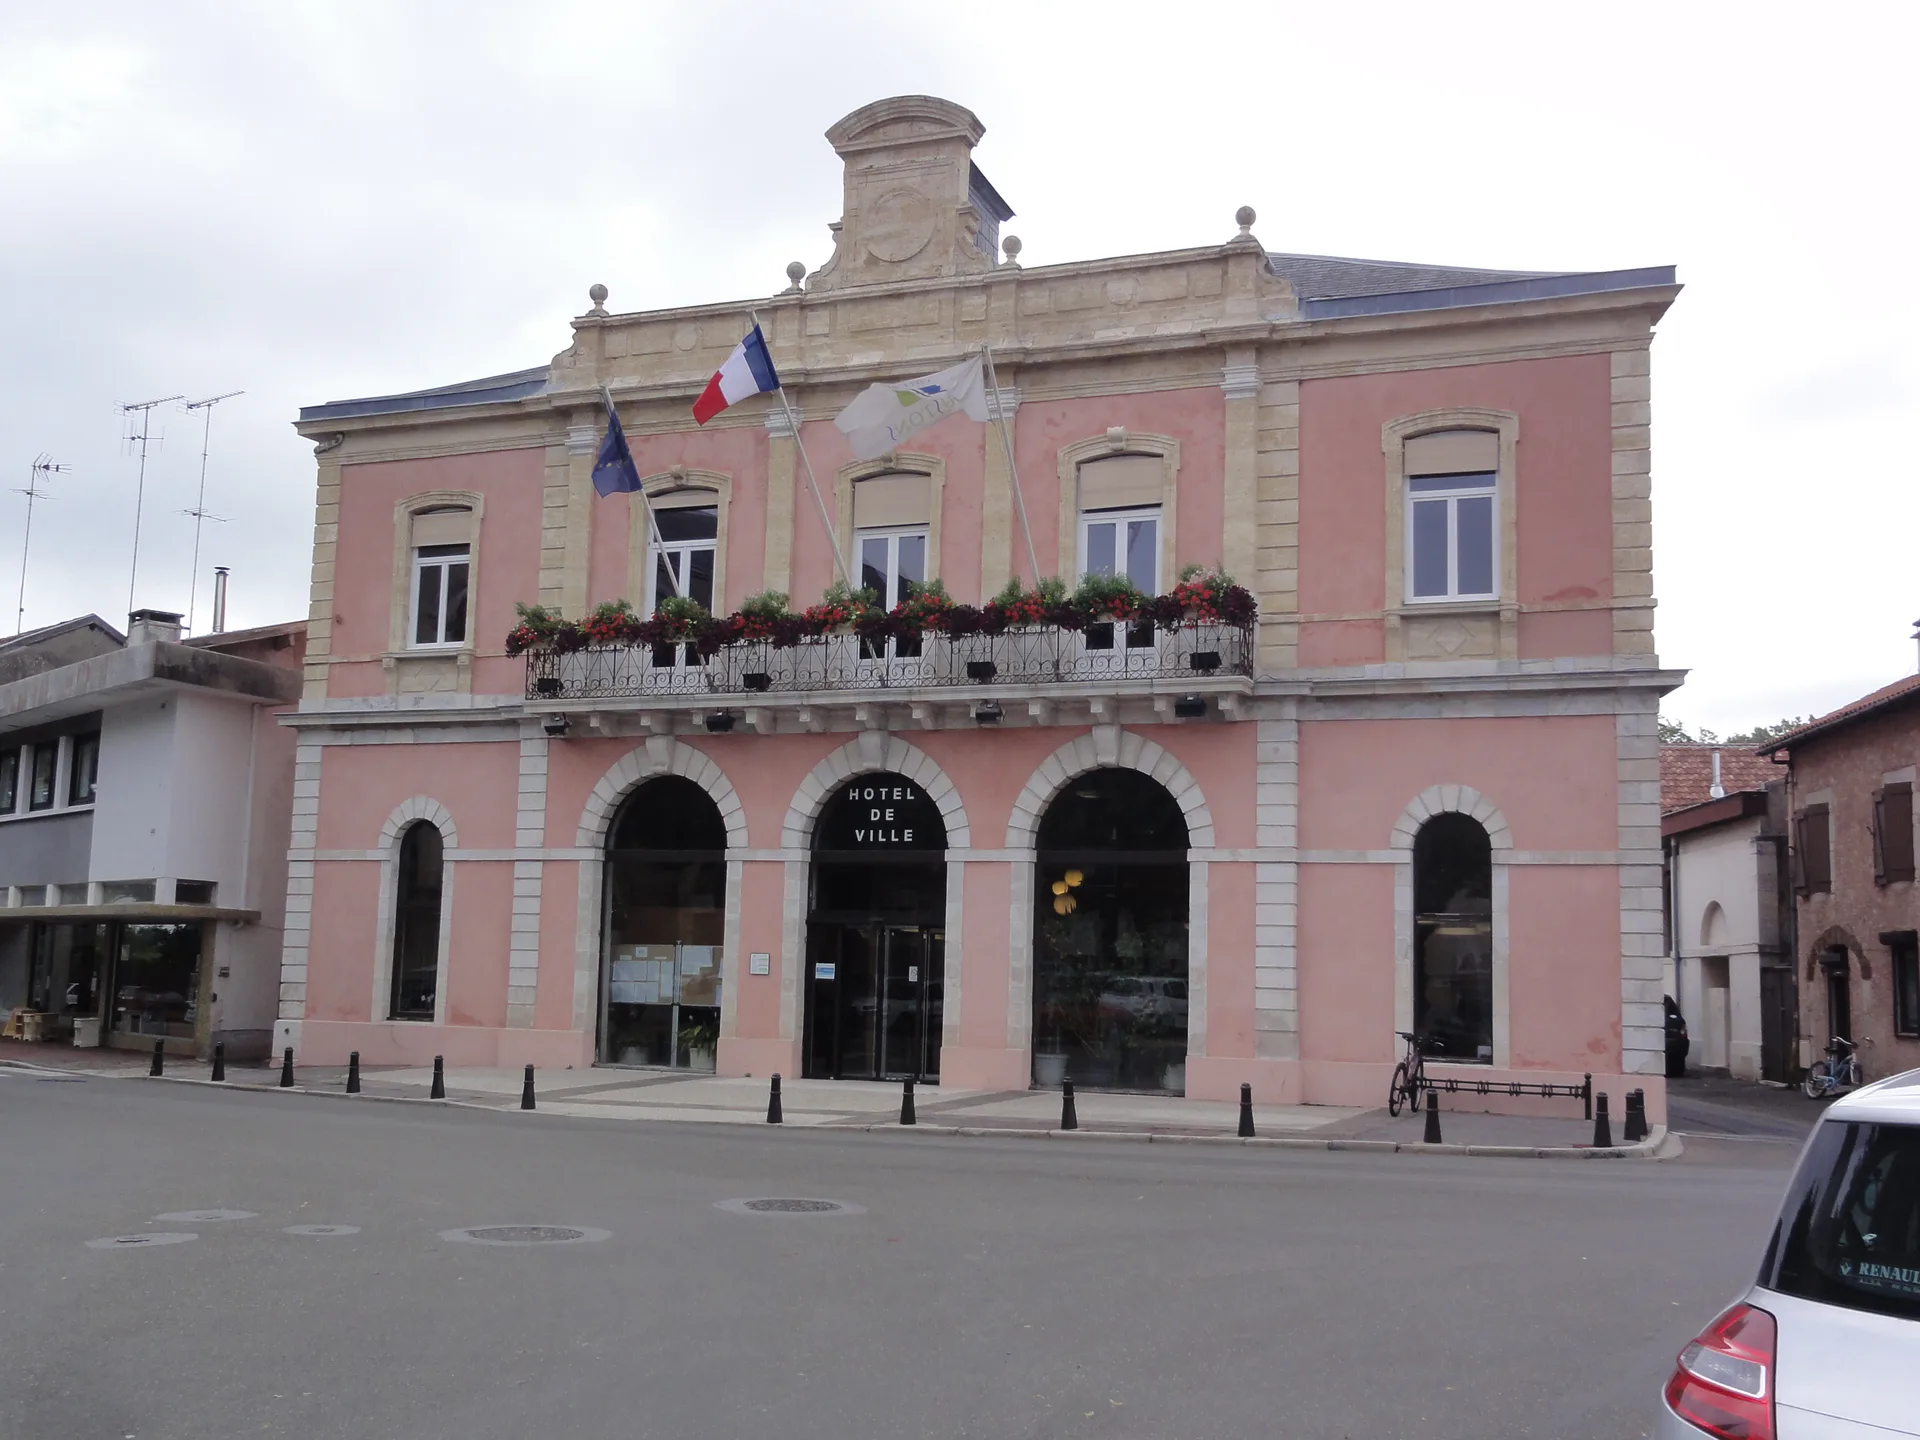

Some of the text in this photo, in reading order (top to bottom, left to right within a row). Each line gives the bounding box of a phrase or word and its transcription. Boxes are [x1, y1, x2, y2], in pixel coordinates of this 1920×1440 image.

[849, 787, 915, 800] HOTEL
[870, 808, 894, 821] DE
[855, 829, 913, 842] VILLE
[1859, 1262, 1920, 1285] RENAUL
